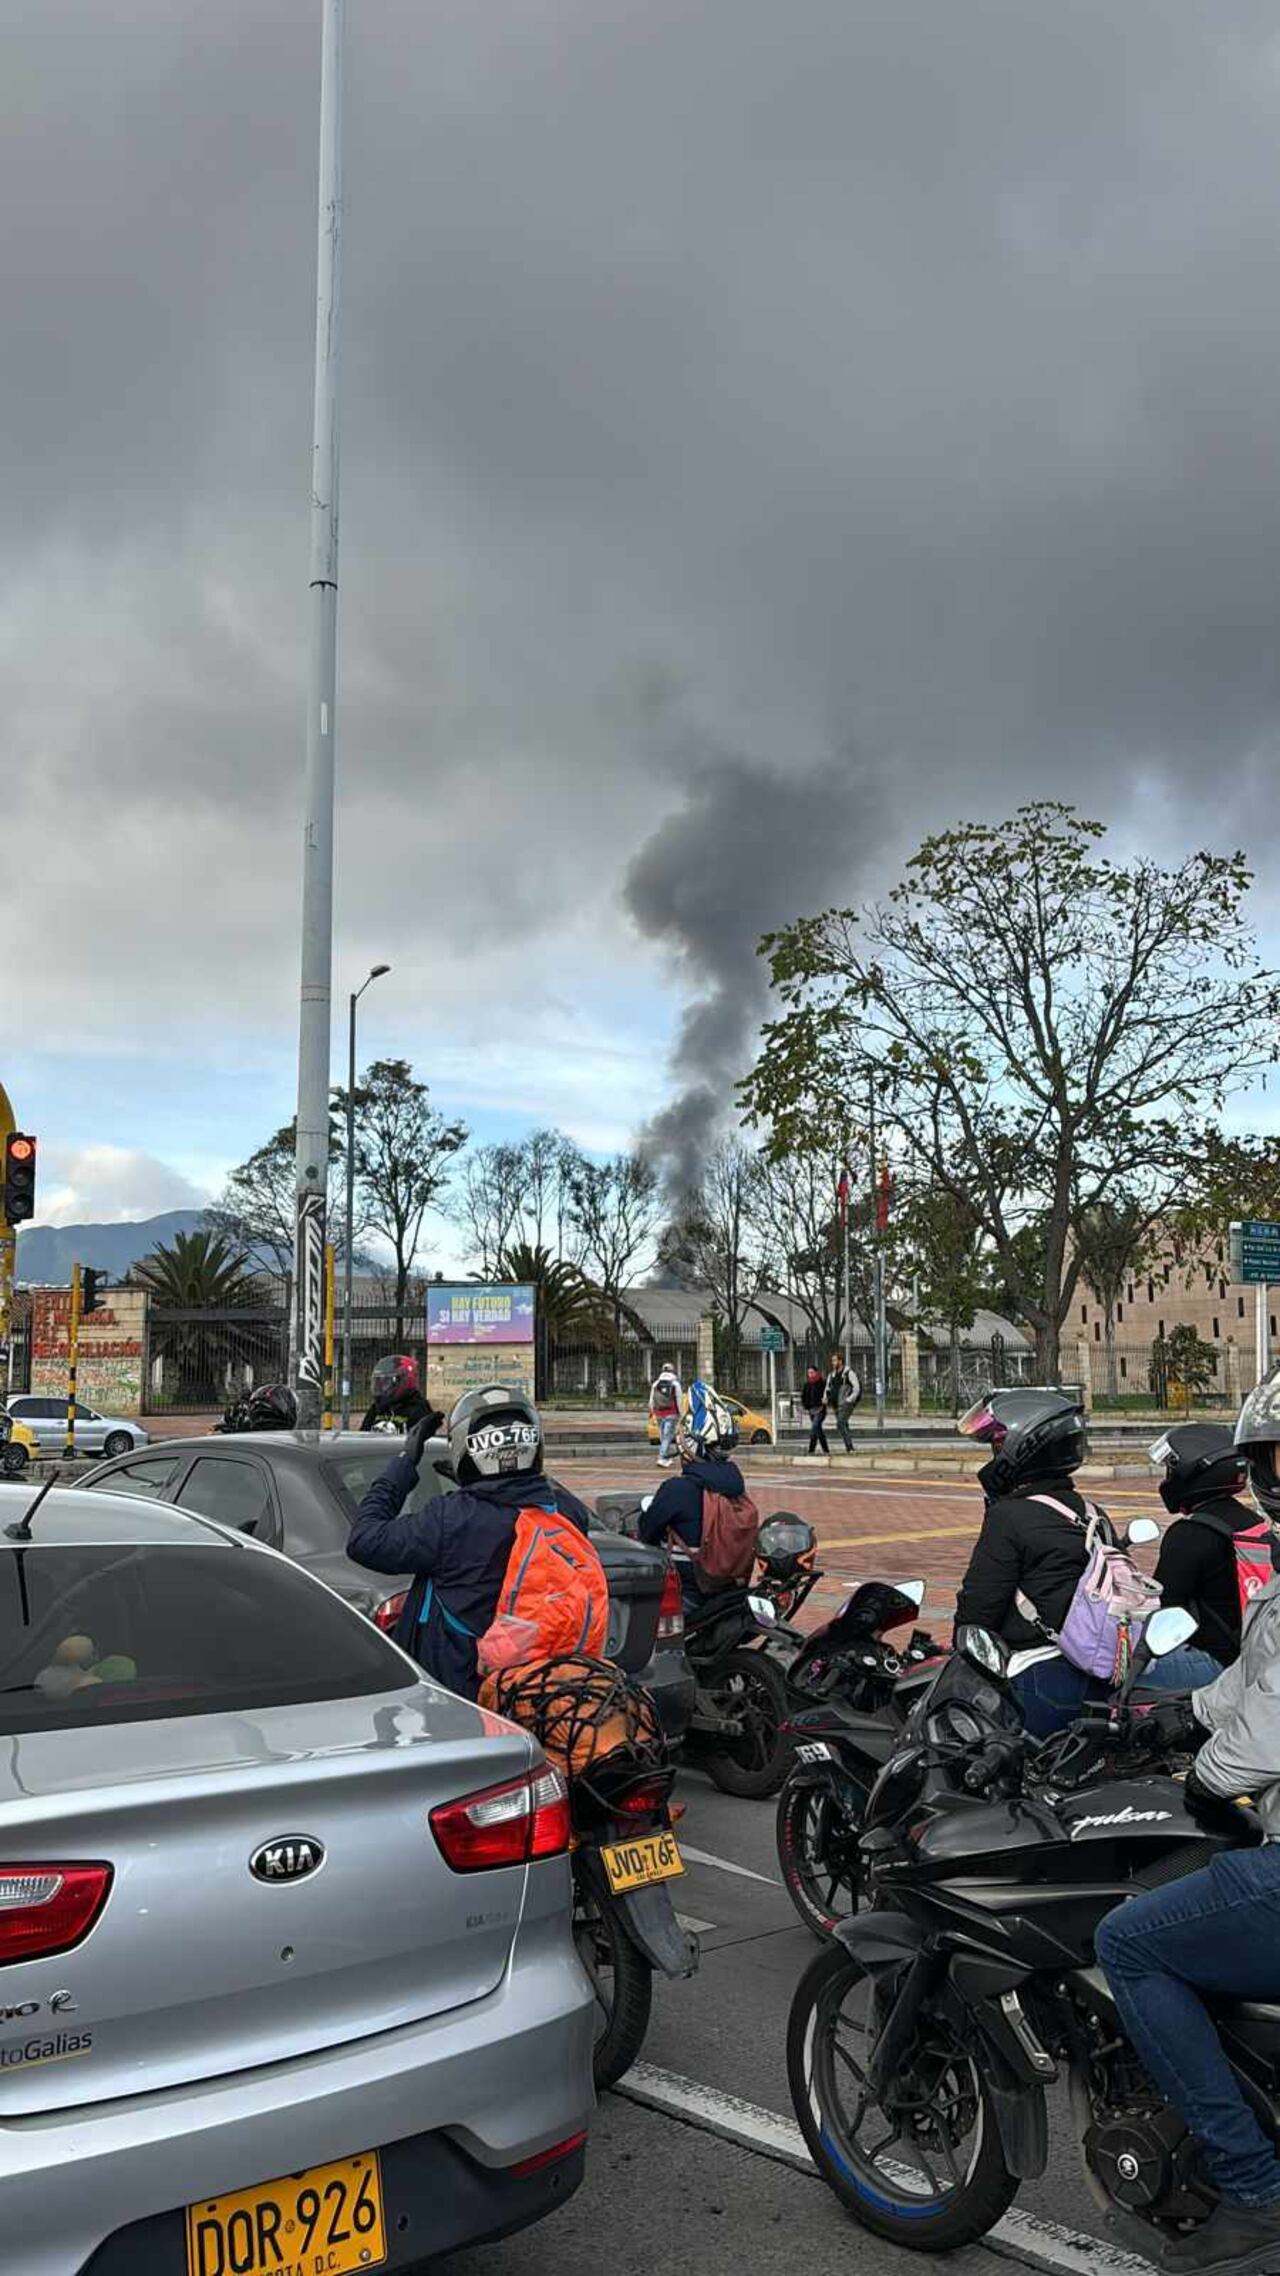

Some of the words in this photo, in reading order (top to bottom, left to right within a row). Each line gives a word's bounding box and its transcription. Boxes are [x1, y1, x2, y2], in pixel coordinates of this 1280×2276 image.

[451, 1296, 470, 1310] HAY
[473, 1296, 511, 1310] FUTURO
[452, 1310, 470, 1321] HAY
[473, 1310, 511, 1321] VERDAD
[34, 1336, 142, 1358] RECOCILIACIÓN
[468, 1427, 537, 1452] JVO-76F
[265, 1845, 314, 1875] KIA
